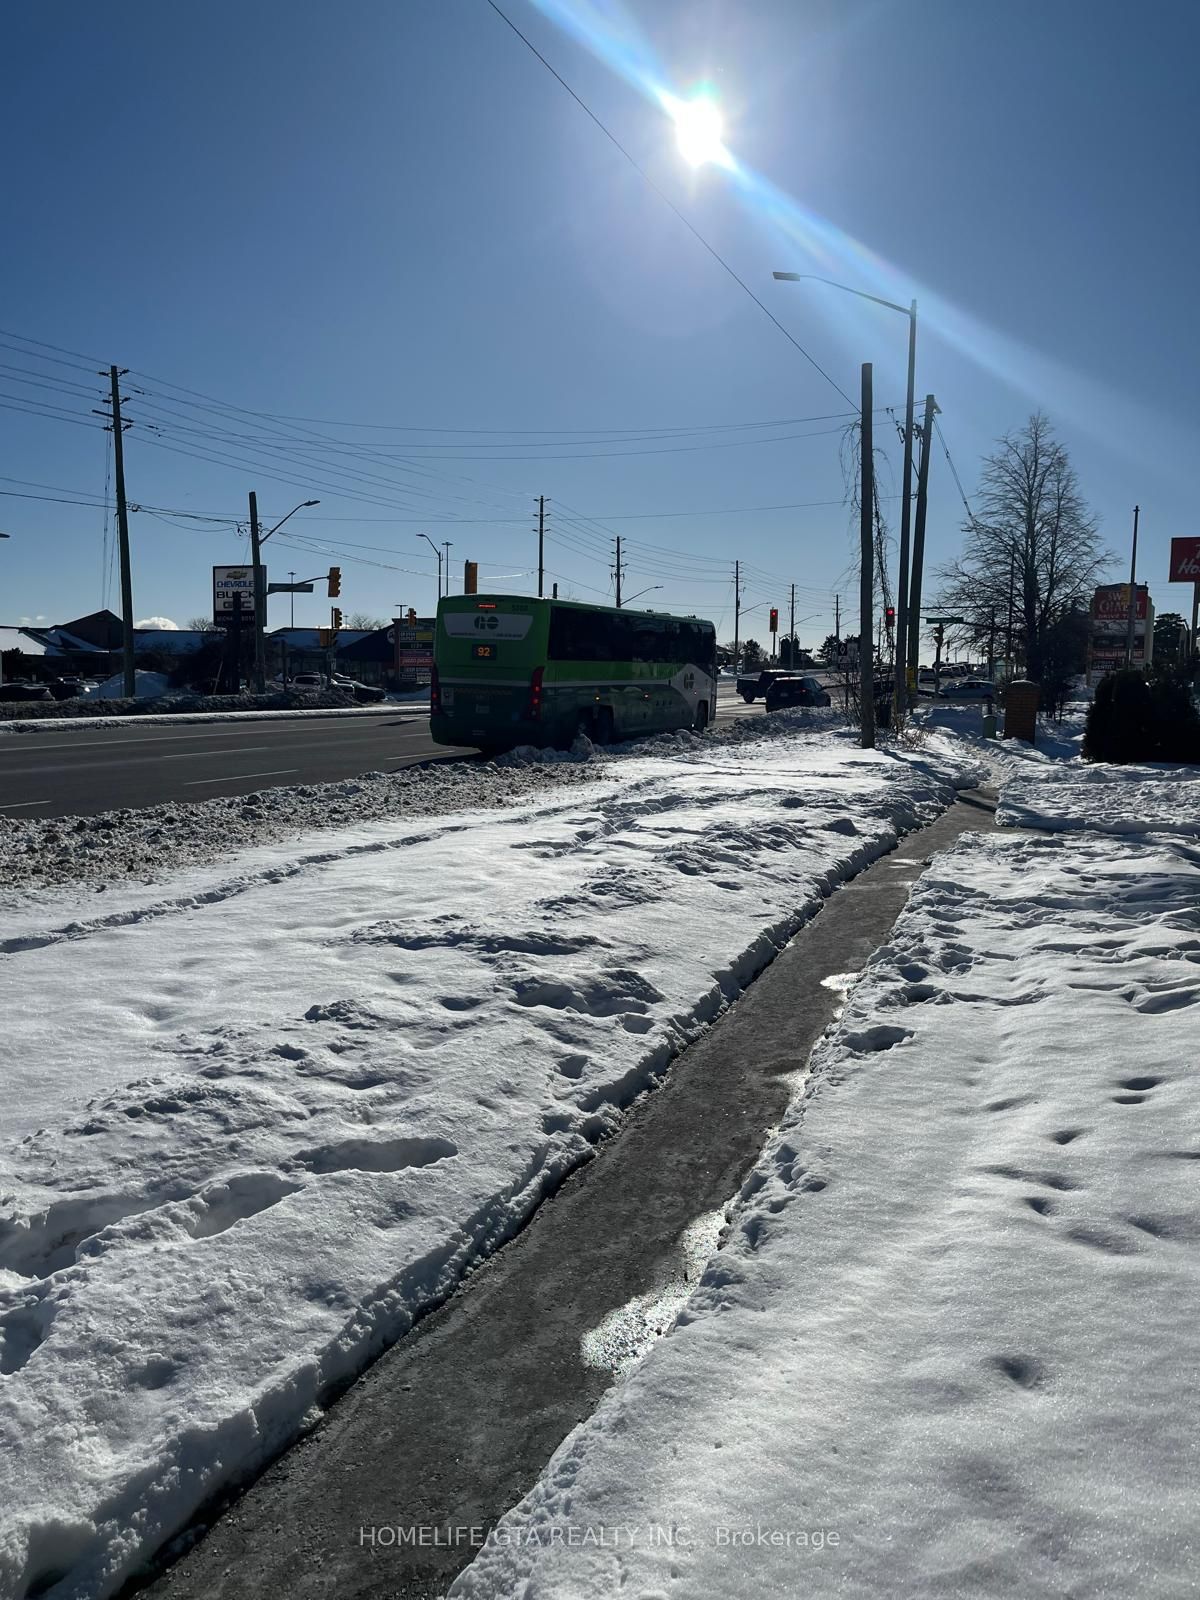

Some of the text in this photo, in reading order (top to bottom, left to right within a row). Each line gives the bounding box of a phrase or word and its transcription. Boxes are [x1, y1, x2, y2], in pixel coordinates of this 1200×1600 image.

[216, 580, 257, 588] CHEVROLE
[216, 590, 256, 599] BUCK
[223, 600, 252, 609] GC
[474, 615, 499, 630] GO
[478, 647, 490, 656] 92
